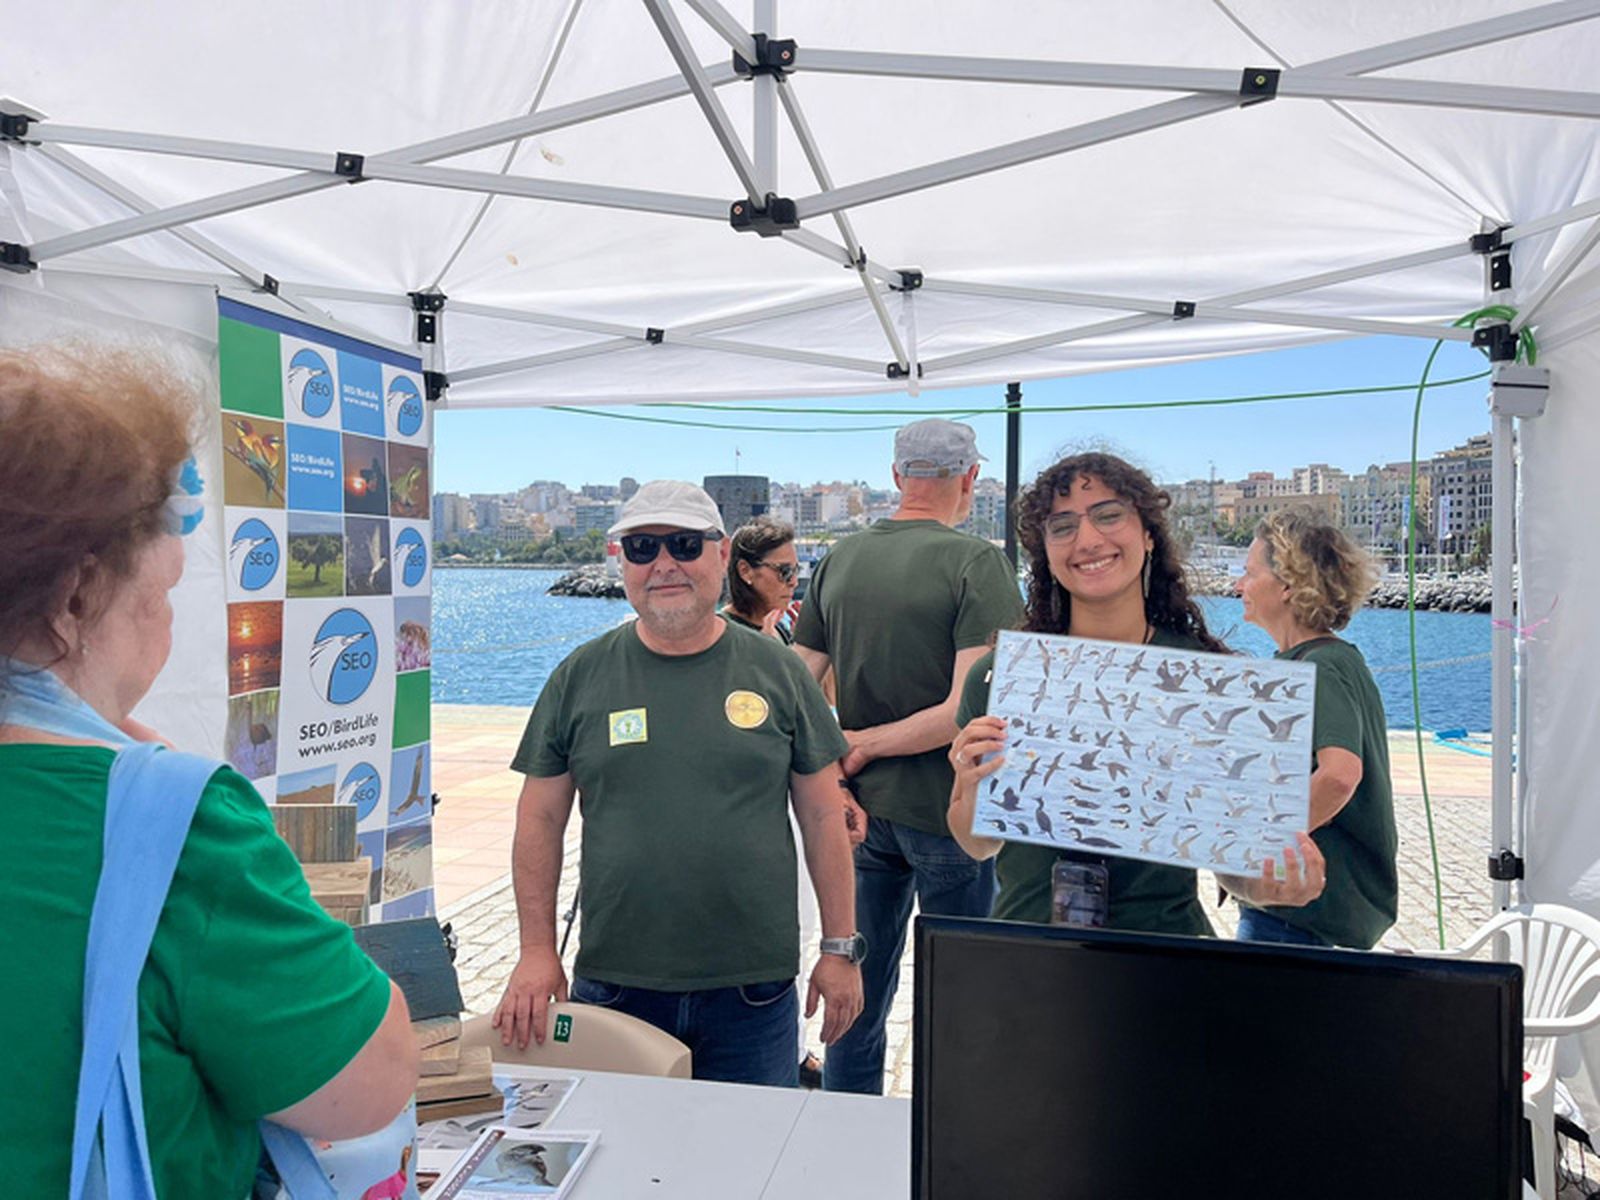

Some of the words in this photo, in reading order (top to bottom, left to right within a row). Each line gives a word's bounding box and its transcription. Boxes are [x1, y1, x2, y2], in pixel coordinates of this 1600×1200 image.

[310, 381, 330, 397] SEO
[402, 404, 419, 418] SEO
[249, 552, 274, 566] SEO
[408, 554, 423, 567] SEO
[341, 652, 371, 671] SEO
[299, 713, 379, 740] SEO/BirdLife
[298, 733, 377, 758] www.seo.org
[556, 1021, 569, 1037] 13
